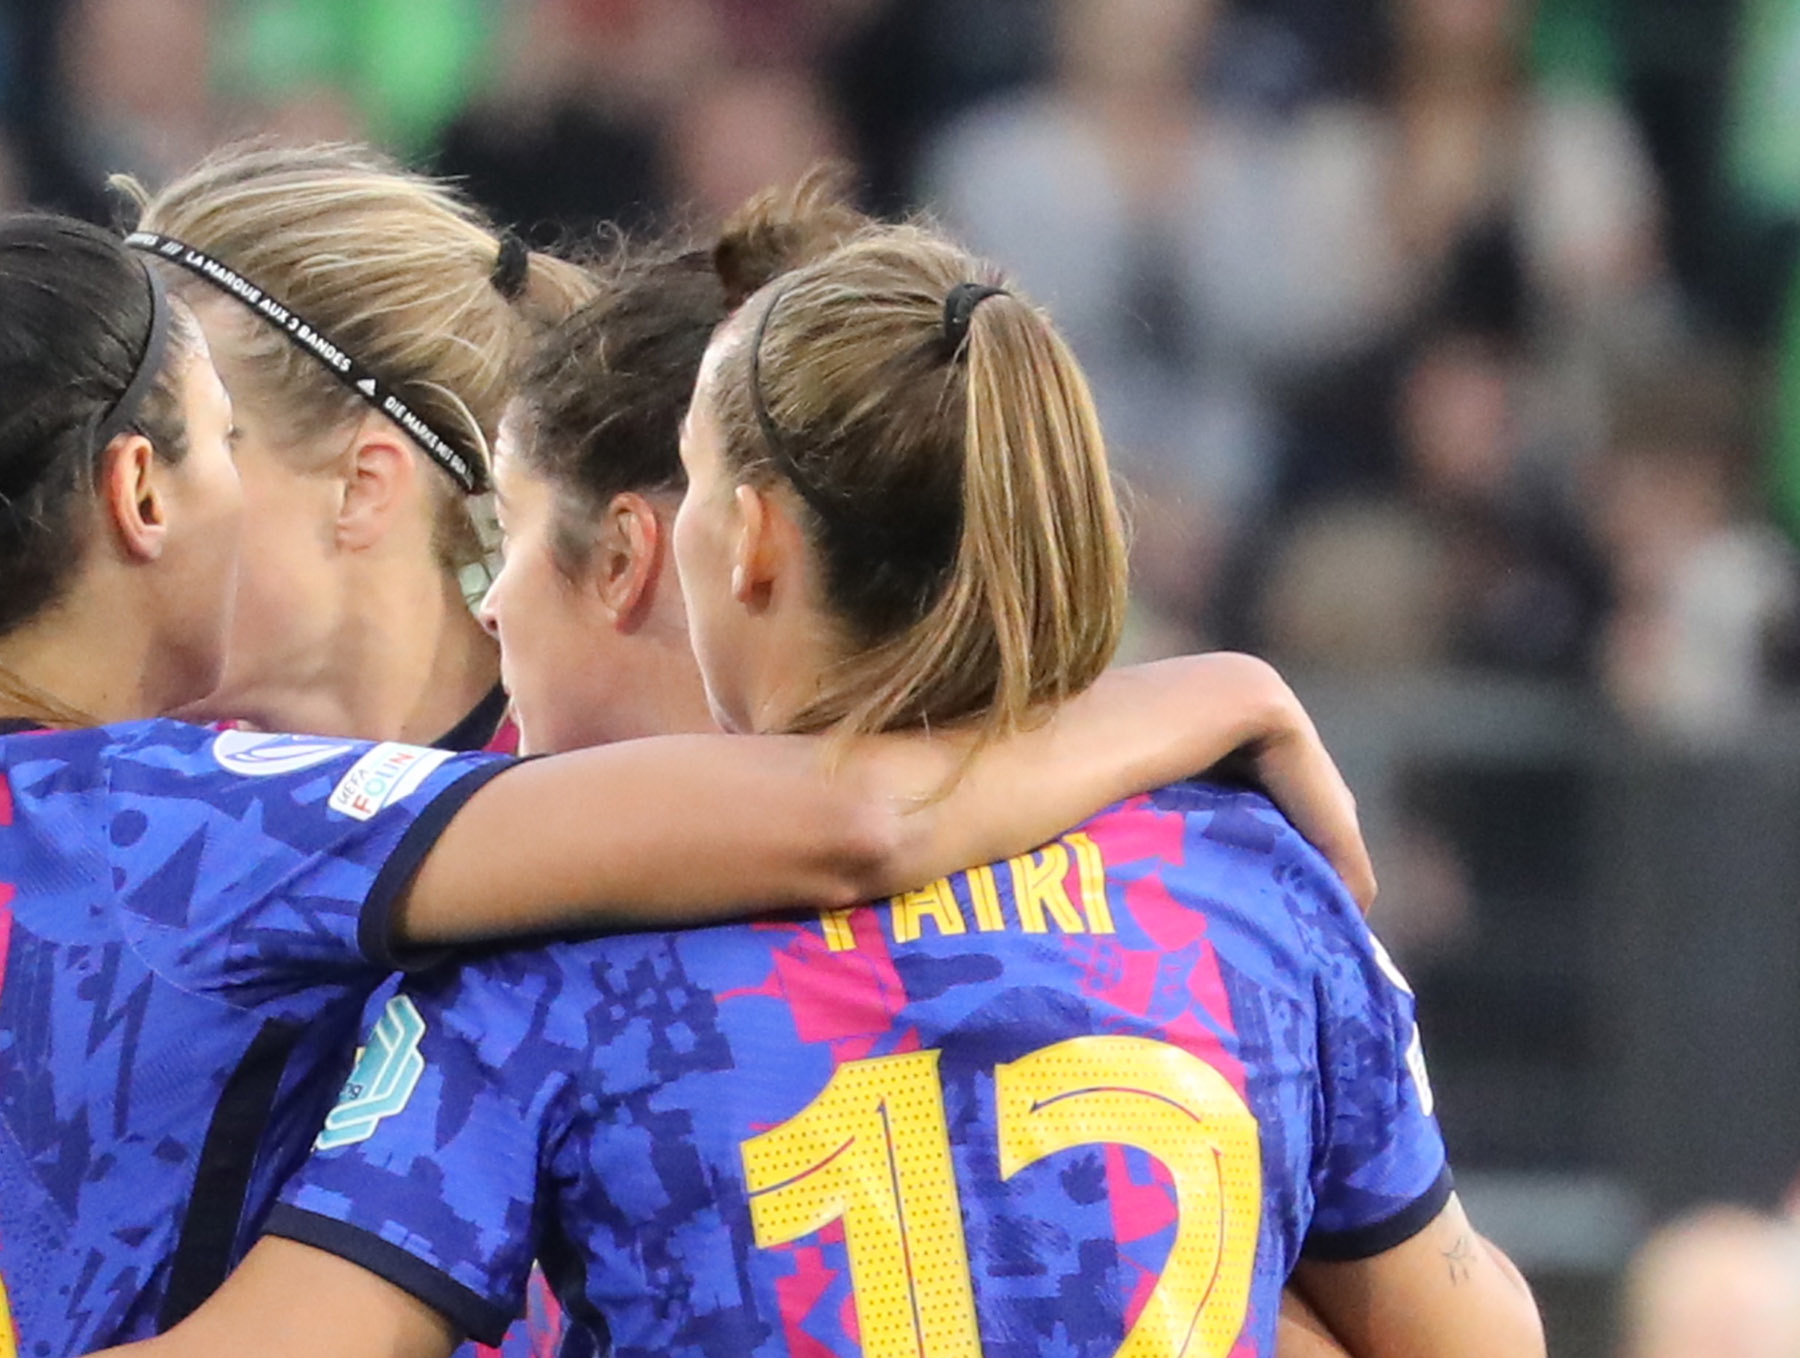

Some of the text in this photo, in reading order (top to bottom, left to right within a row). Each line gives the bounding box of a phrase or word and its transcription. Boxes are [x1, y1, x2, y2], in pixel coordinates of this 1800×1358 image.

[185, 251, 352, 374] LA MARQUE AUX 3 BANDES
[338, 767, 369, 806] UEFA
